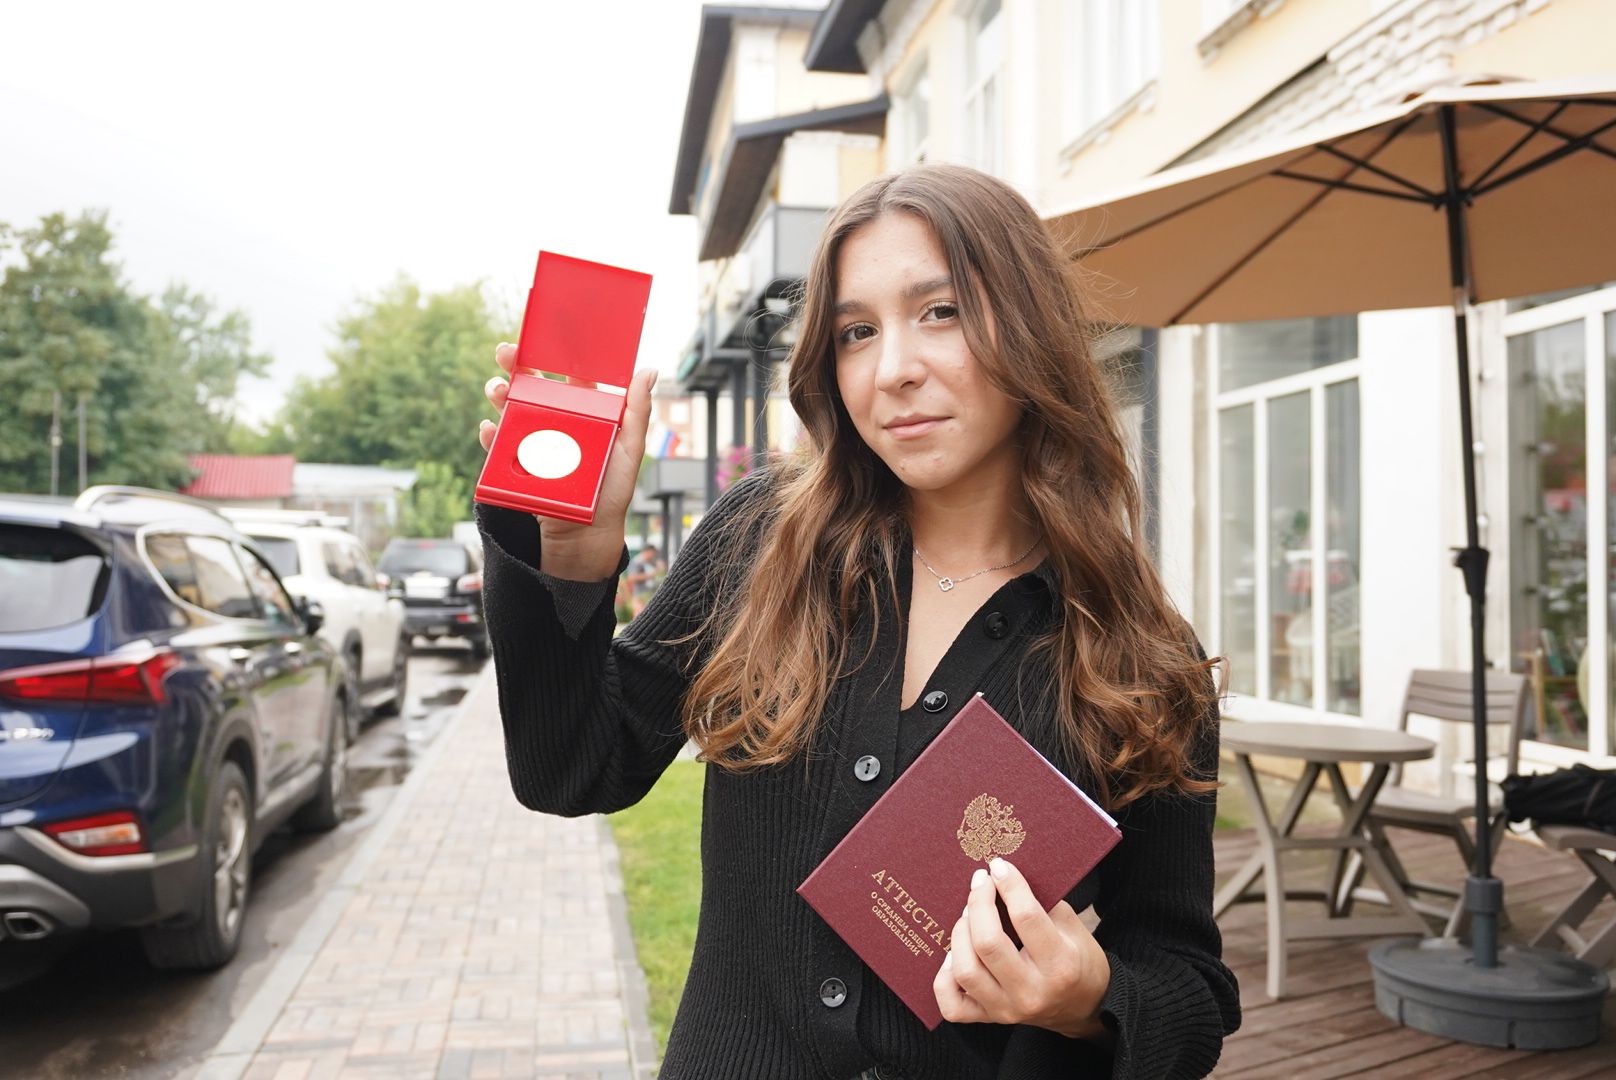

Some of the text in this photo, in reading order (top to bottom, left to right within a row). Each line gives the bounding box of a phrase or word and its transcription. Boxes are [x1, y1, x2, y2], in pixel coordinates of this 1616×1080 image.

[872, 906, 920, 955] ОБРАЗОВАНИИ
[877, 898, 909, 931] СРЕДНЕМ
[908, 929, 934, 956] ОБЩЕМ
